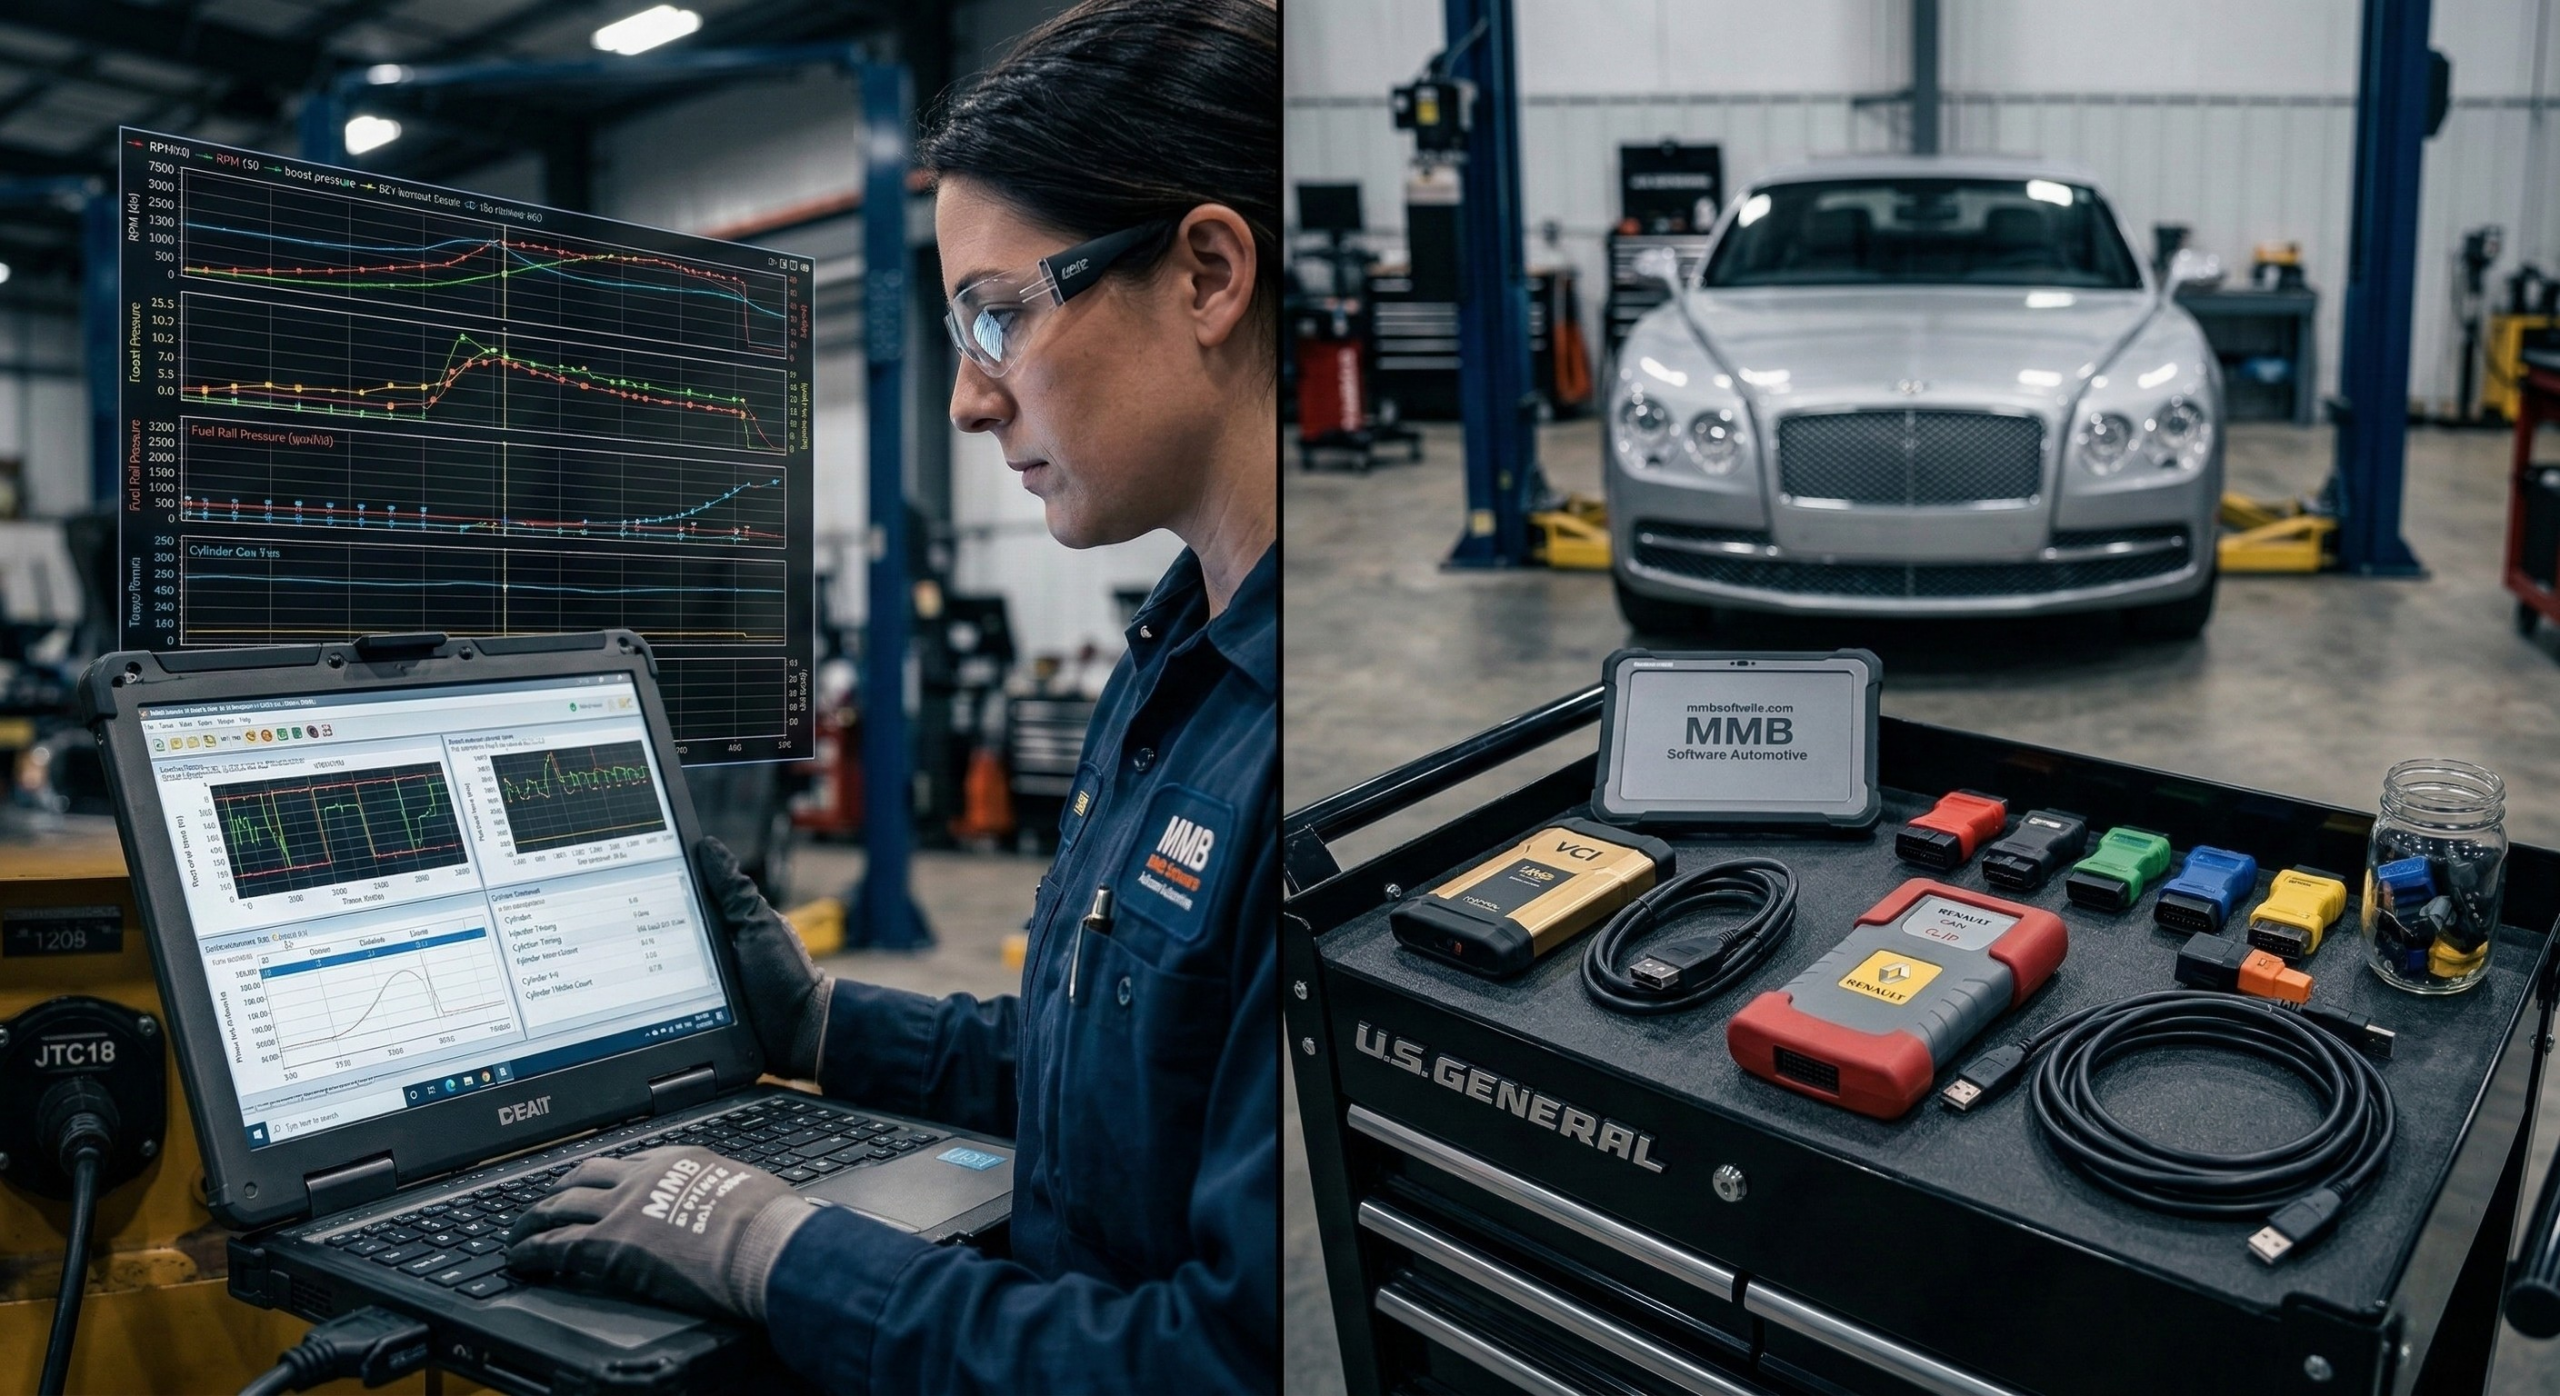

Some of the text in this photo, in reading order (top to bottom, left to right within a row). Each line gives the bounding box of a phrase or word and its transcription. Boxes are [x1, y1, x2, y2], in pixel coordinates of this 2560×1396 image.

[216, 153, 240, 167] RPM
[148, 160, 175, 175] 7500
[148, 178, 175, 192] 3000
[148, 196, 175, 210] 2500
[149, 214, 175, 228] 1300
[149, 232, 175, 246] 1000
[154, 251, 175, 263] 500
[167, 270, 175, 280] 0
[151, 333, 174, 344] 10.2
[157, 351, 175, 362] 7.0
[157, 385, 175, 396] 0.0
[148, 422, 175, 434] 3200
[191, 425, 215, 437] Fuel
[240, 429, 287, 443] Pressure
[148, 437, 175, 448] 2500
[148, 452, 175, 463] 2000
[149, 482, 175, 493] 1000
[154, 497, 175, 508] 500
[167, 514, 175, 523] 0
[154, 536, 175, 546] 250
[154, 552, 175, 562] 300
[189, 545, 233, 558] Cylinder
[154, 569, 175, 579] 250
[154, 585, 175, 596] 450
[154, 601, 175, 612] 240
[154, 618, 175, 629] 160
[166, 635, 175, 646] 0
[1685, 717, 1794, 745] MMB
[1666, 748, 1808, 761] Software Automotive
[1156, 815, 1215, 873] MMB
[1555, 840, 1604, 862] VCI
[1938, 908, 1993, 926] RENAULT
[1846, 978, 1906, 1002] RENAULT
[34, 1040, 116, 1069] JTC18
[641, 1158, 701, 1219] MMB
